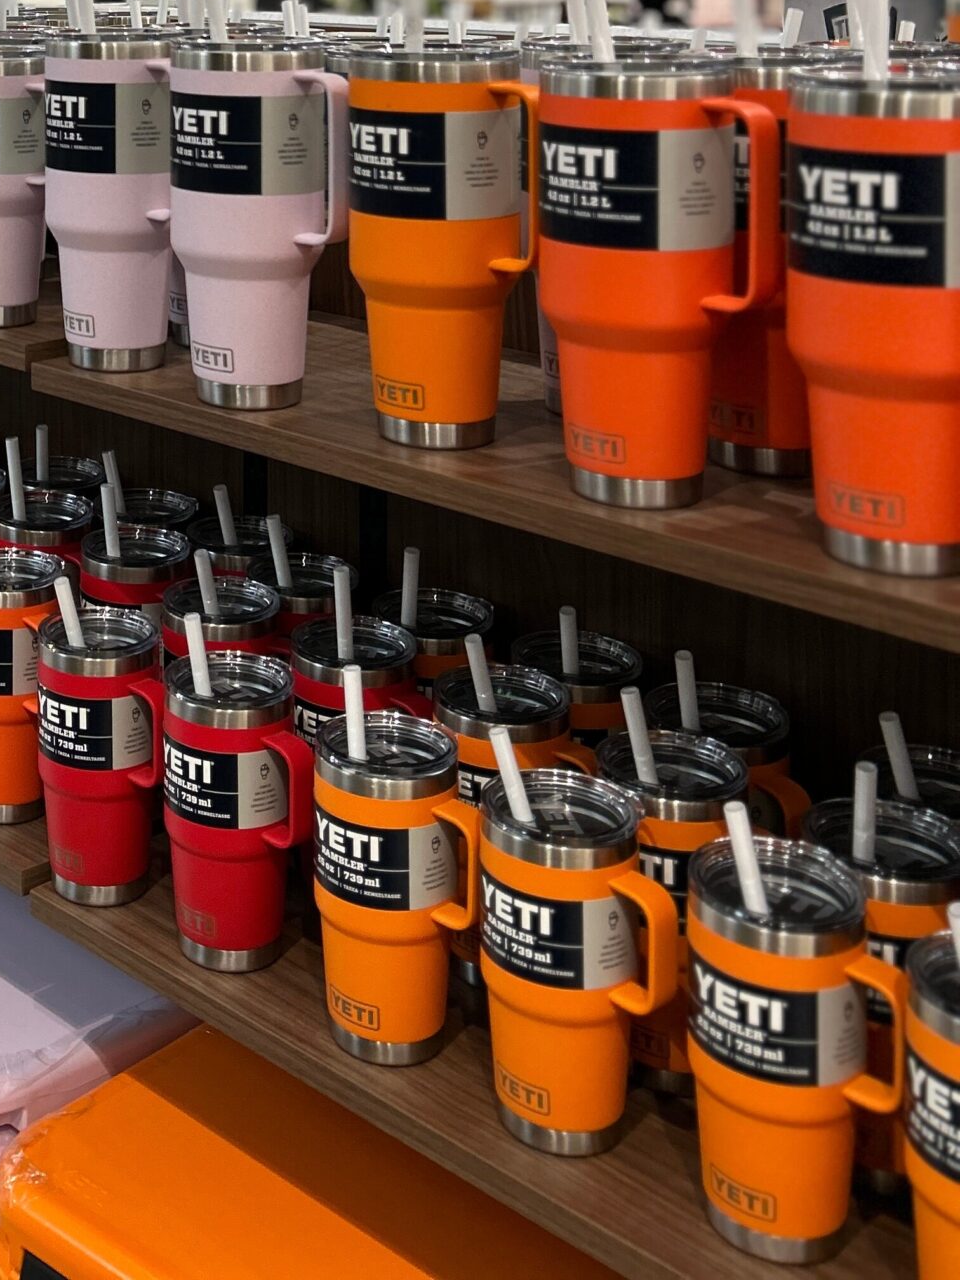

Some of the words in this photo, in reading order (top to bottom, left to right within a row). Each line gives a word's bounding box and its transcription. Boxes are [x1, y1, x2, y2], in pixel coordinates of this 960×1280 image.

[45, 93, 86, 119] YETI
[172, 106, 228, 135] YETI
[64, 131, 75, 140] 1.2
[76, 132, 83, 141] L
[176, 133, 215, 146] RAMBLER
[349, 122, 409, 155] YETI
[201, 149, 215, 159] 1.2
[216, 150, 224, 160] L
[353, 152, 395, 166] RAMBLER
[542, 140, 616, 179] YETI
[379, 169, 395, 180] 1.2
[396, 170, 405, 181] L
[548, 175, 599, 191] RAMBLER
[798, 164, 898, 210] YETI
[581, 195, 598, 207] 1.2
[601, 196, 611, 208] L
[853, 226, 877, 241] 1.2
[879, 227, 893, 243] L
[170, 295, 187, 311] YE
[65, 315, 90, 333] YETI
[194, 347, 228, 368] YETI
[377, 381, 418, 405] YETI
[571, 429, 618, 458] YETI
[833, 489, 895, 521] YETI
[40, 694, 88, 730] YETI
[294, 705, 331, 735] YE
[41, 719, 76, 739] RAMBLER
[58, 738, 74, 752] 739
[75, 743, 88, 753] ml
[164, 743, 212, 784] YETI
[166, 767, 199, 793] RAMBLER
[457, 770, 491, 797] ET
[181, 791, 198, 806] 739
[198, 798, 212, 807] ml
[315, 809, 380, 862] YETI
[321, 844, 365, 872] RAMBLER
[639, 852, 674, 885] TI
[325, 862, 335, 874] oz
[343, 870, 363, 885] 739
[364, 877, 381, 888] ml
[482, 874, 550, 936] YETI
[487, 911, 535, 945] RAMBLER
[491, 931, 502, 944] oz
[510, 942, 533, 959] 739
[534, 952, 551, 964] ml
[332, 990, 374, 1025] YETI
[695, 962, 784, 1032] YETI
[703, 1005, 765, 1042] RAMBLER
[735, 1039, 762, 1057] 739
[763, 1049, 784, 1063] ml
[500, 1073, 543, 1109] YETI
[909, 1055, 960, 1120] YE
[712, 1170, 769, 1216] YETI
